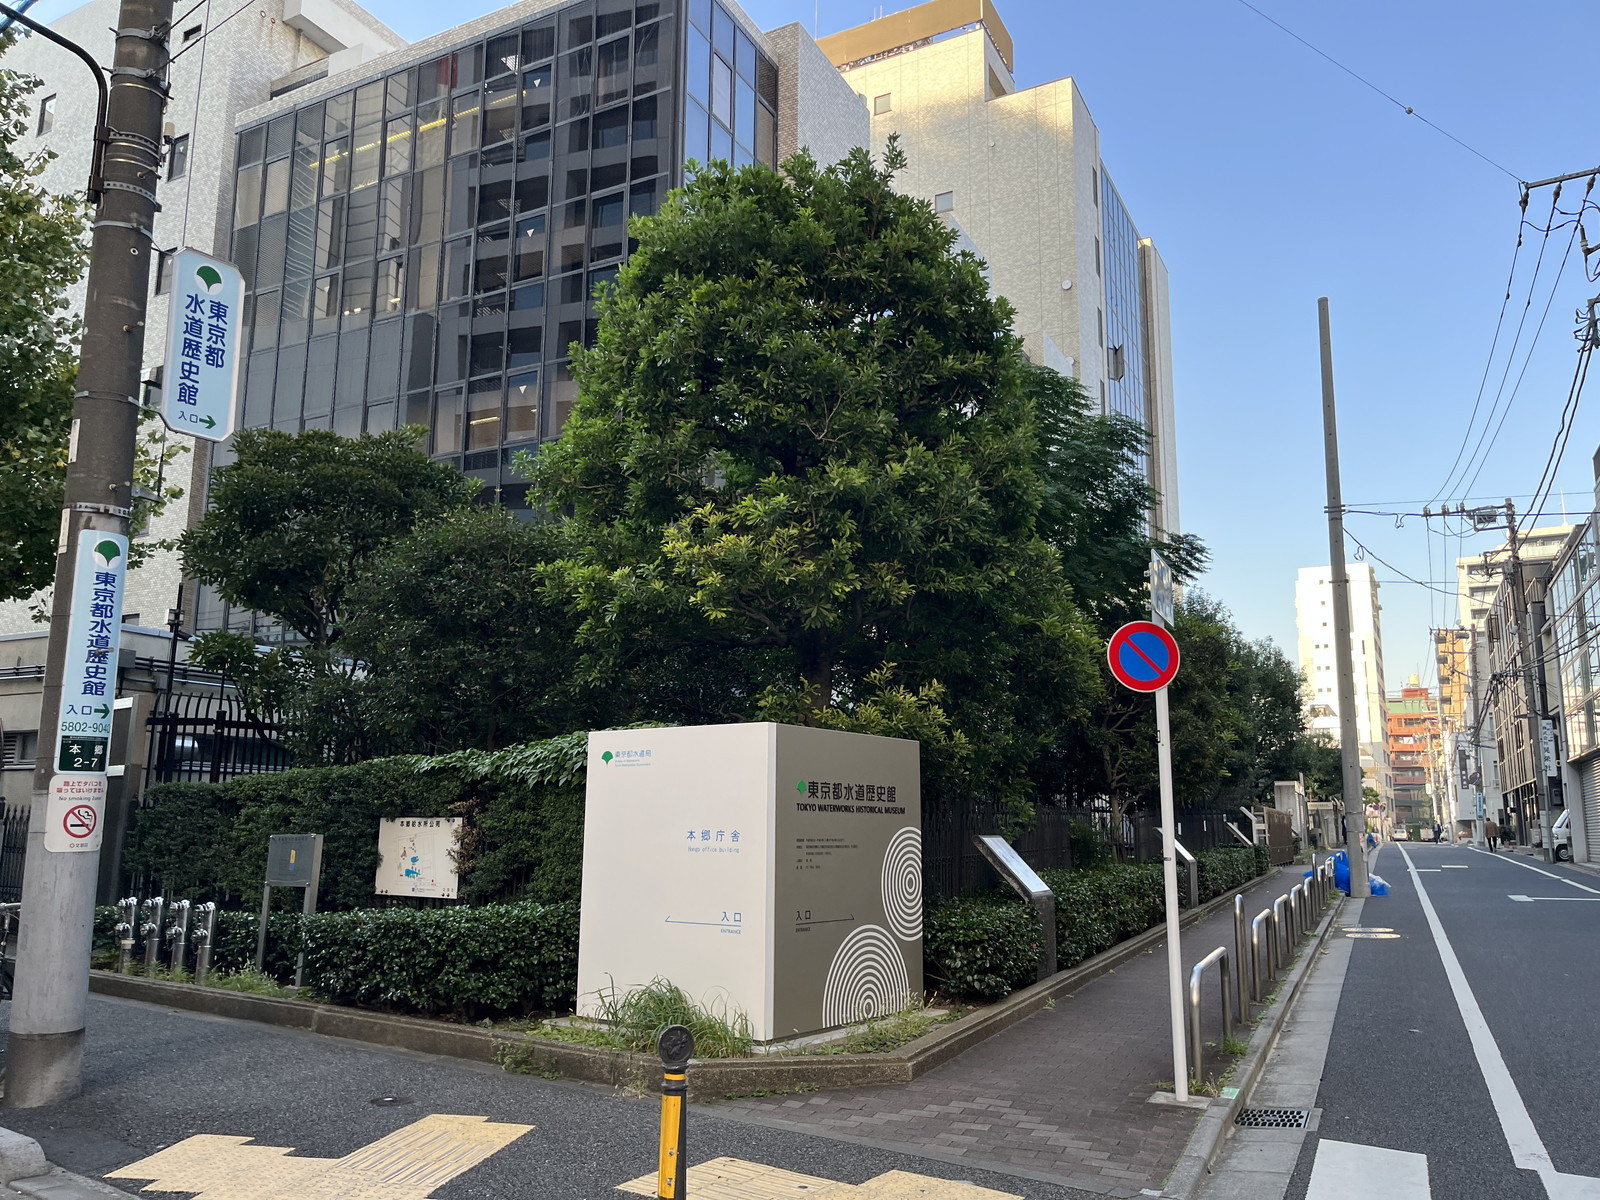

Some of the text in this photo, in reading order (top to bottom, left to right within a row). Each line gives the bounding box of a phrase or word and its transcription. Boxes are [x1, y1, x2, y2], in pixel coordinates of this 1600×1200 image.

[204, 299, 229, 369] 東京都
[177, 293, 206, 406] 水道歴史館
[178, 410, 198, 424] 入口
[81, 571, 117, 696] 東京都水道歴史館
[66, 704, 93, 715] 入口
[61, 721, 110, 733] 5802-9040
[69, 744, 103, 755] 本郷
[73, 757, 98, 768] 2-7
[807, 781, 897, 803] 東京都水道歴史館
[796, 803, 906, 815] TOKYO WATERWORKS HISTORICAL MUSEUM
[687, 829, 740, 842] 本郷庁舎
[721, 911, 742, 923] 入口
[795, 910, 811, 921] 入口
